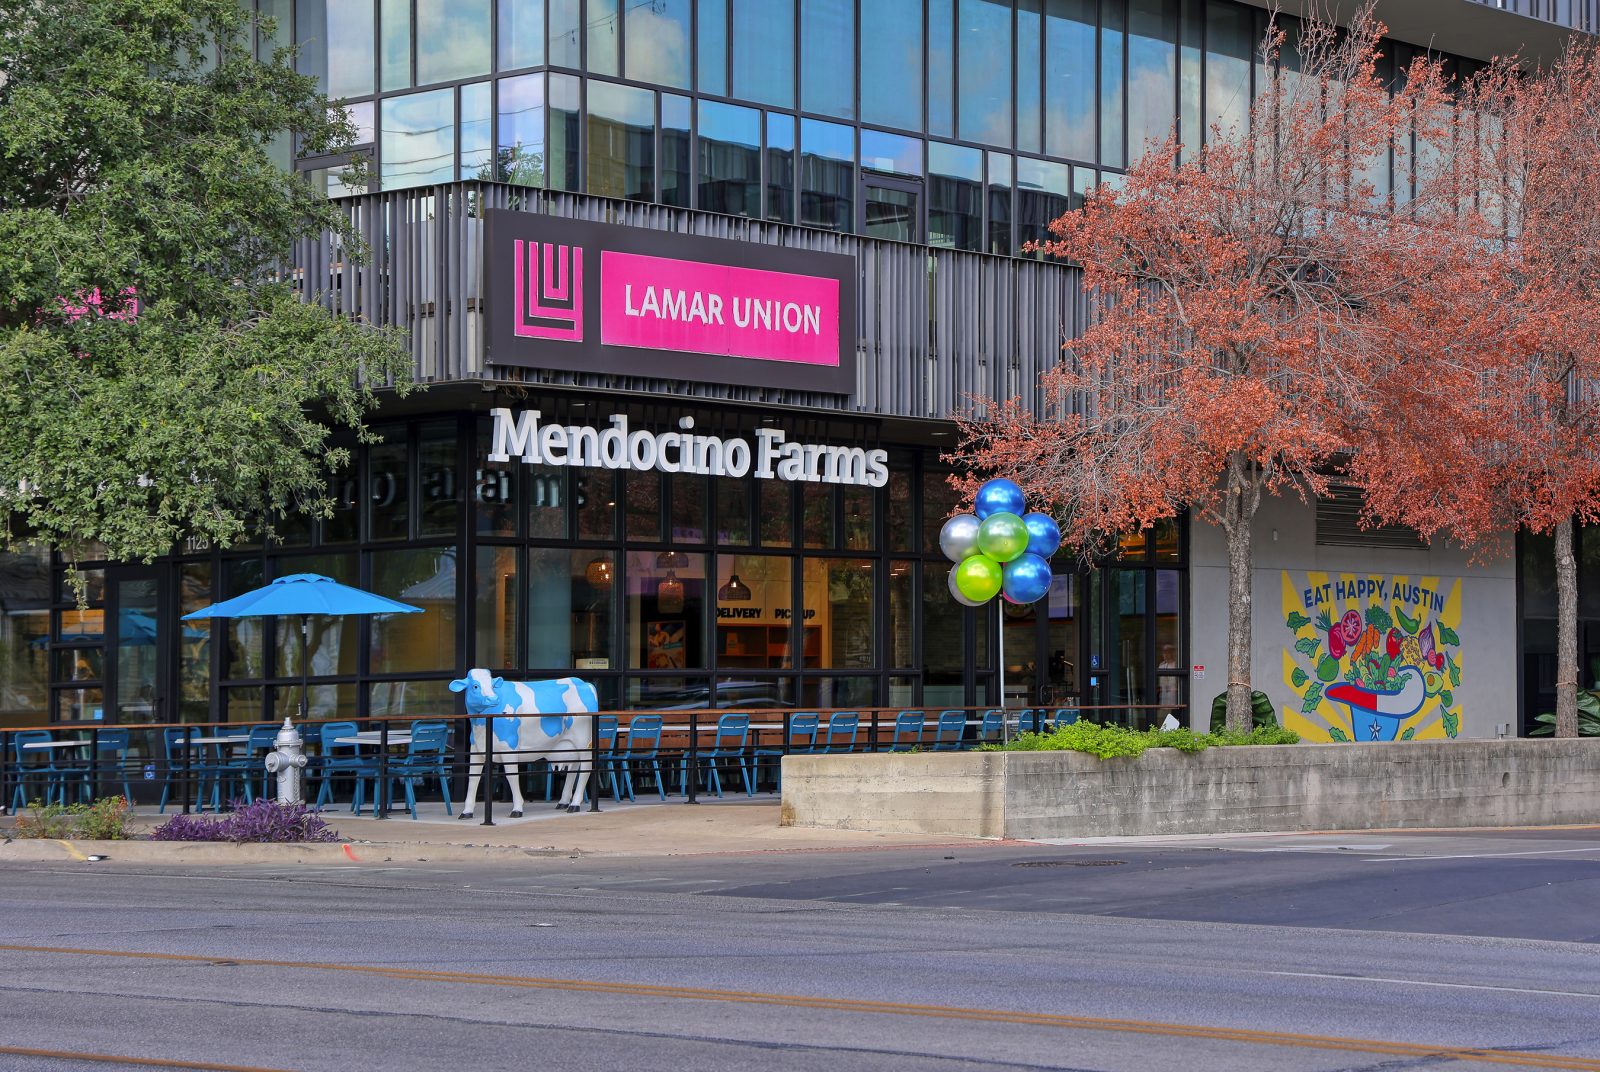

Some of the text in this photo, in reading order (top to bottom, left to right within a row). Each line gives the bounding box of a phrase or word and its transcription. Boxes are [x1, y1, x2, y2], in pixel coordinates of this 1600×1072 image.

[624, 284, 821, 335] LAMAR UNION
[487, 407, 890, 488] Mendocino Farms
[716, 607, 762, 619] DELIVERY
[1304, 579, 1444, 613] EAT HAPPY, AUSTIN
